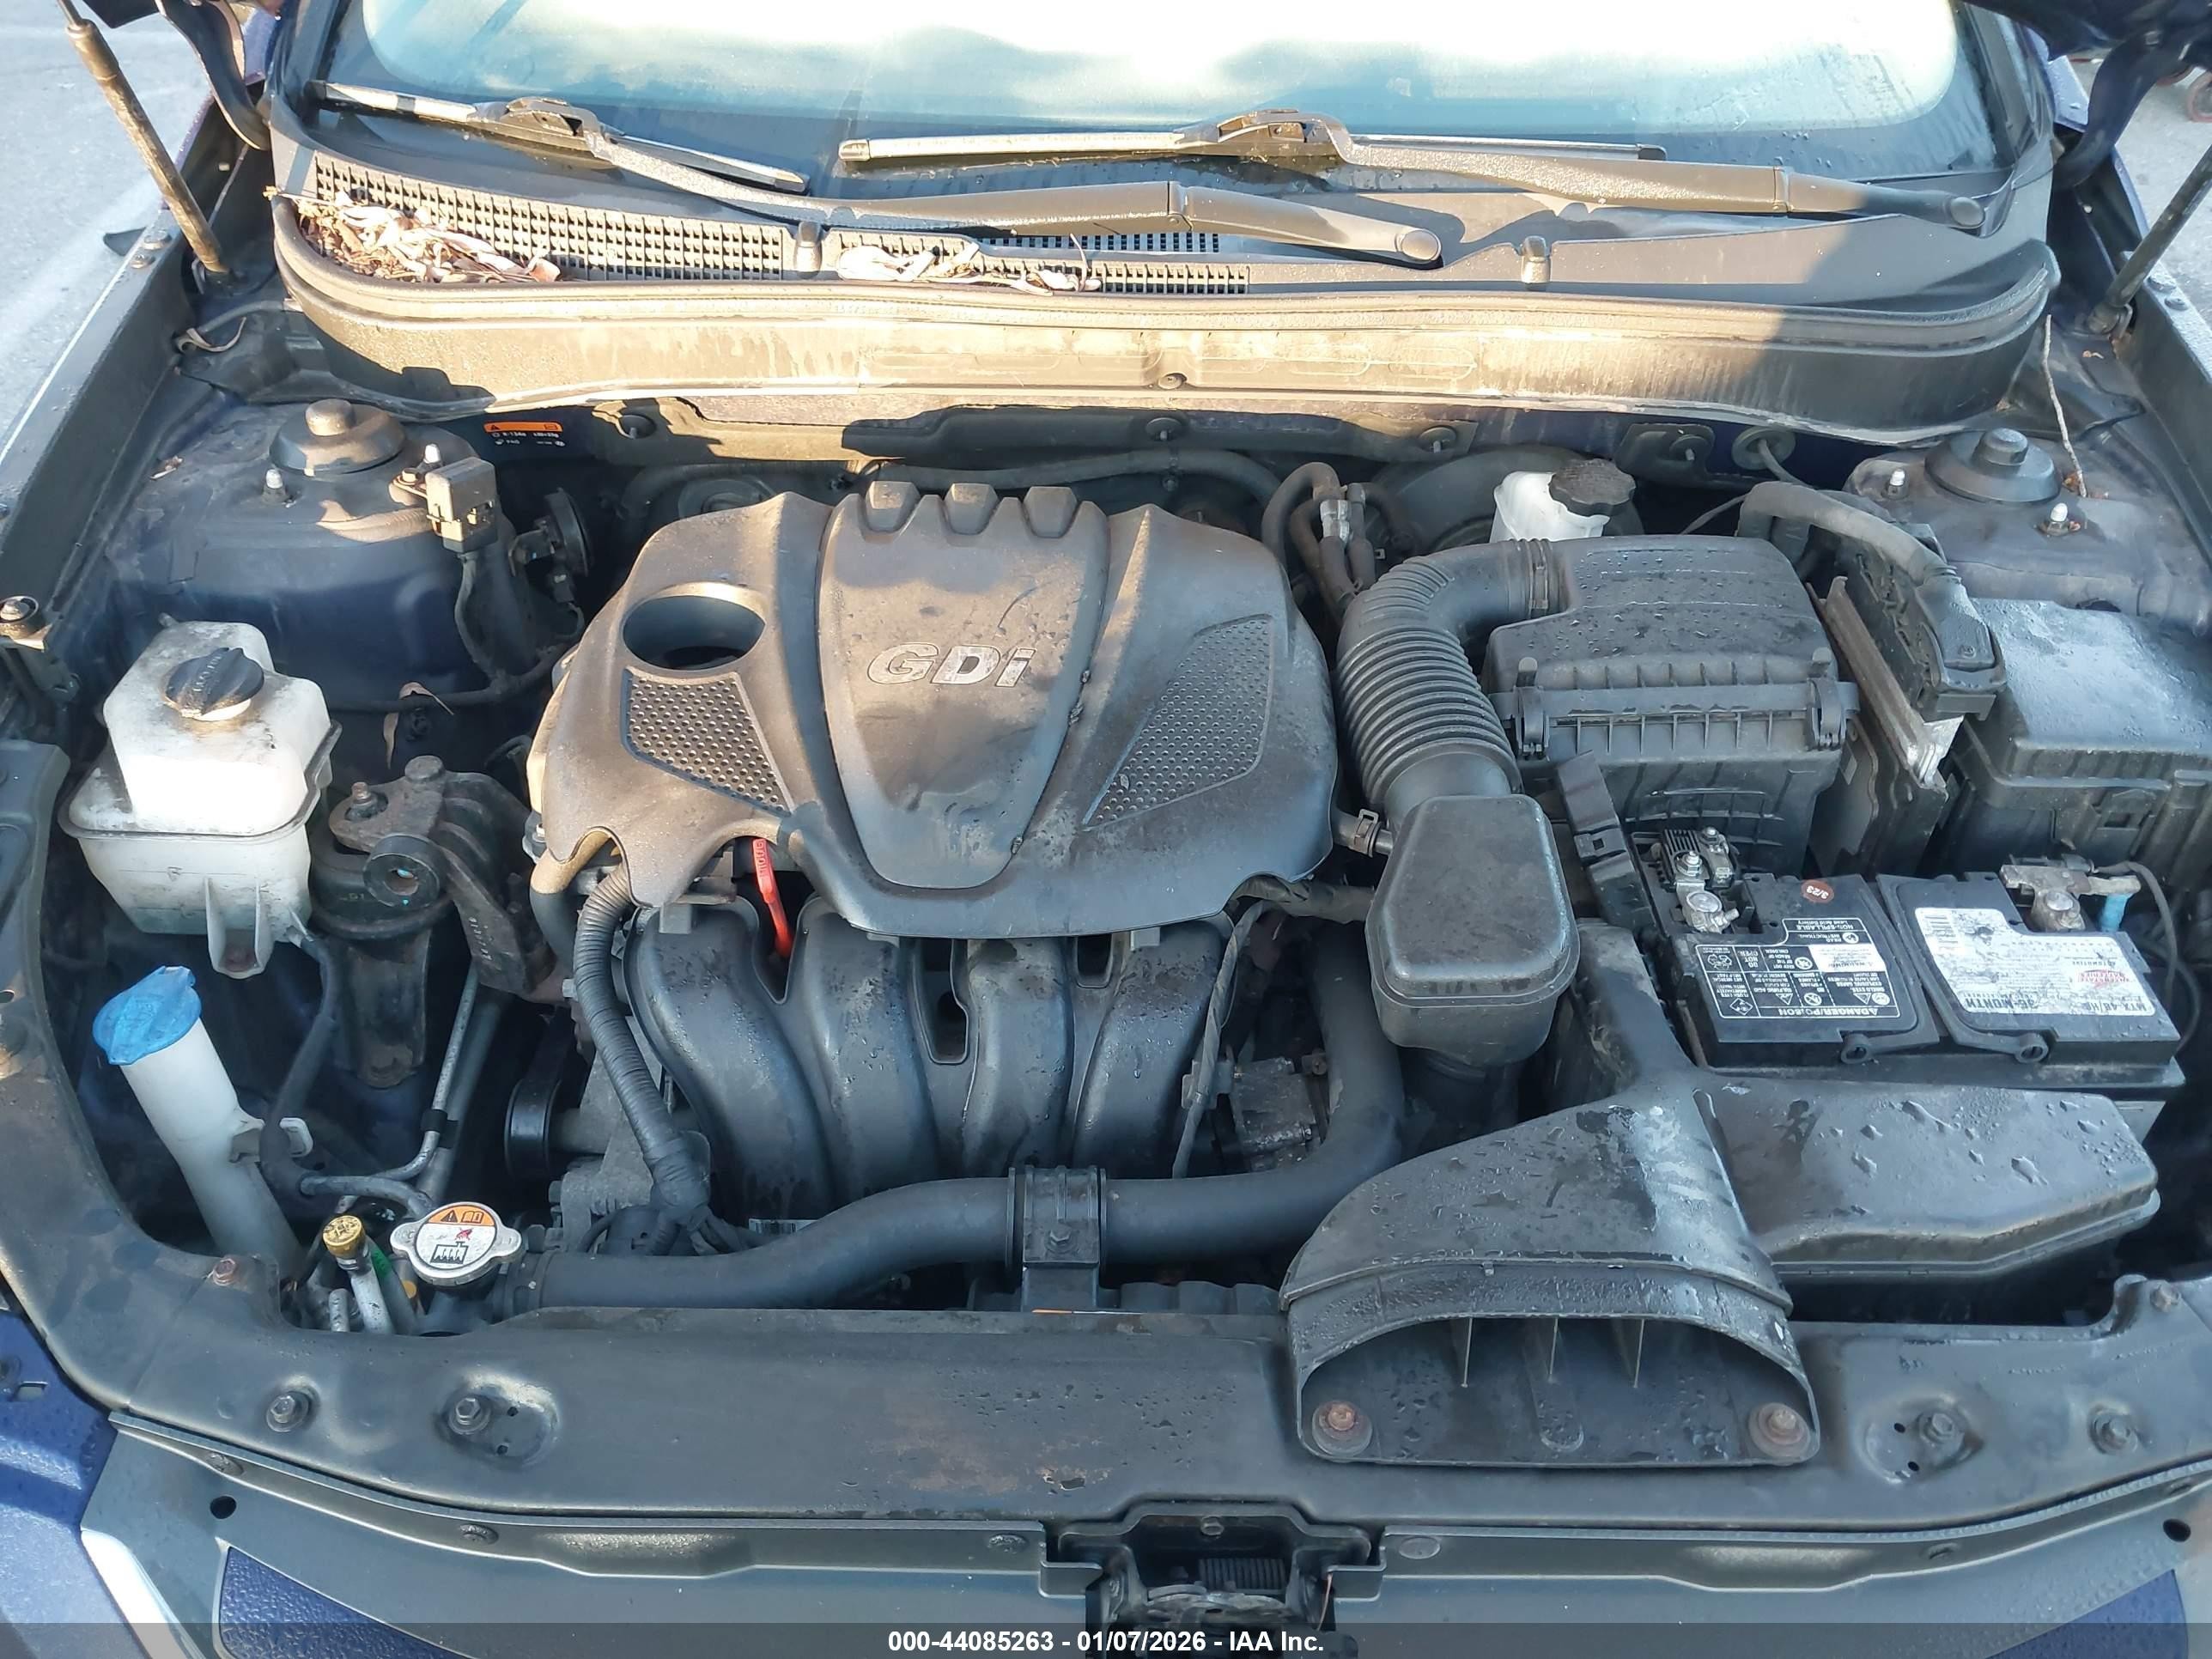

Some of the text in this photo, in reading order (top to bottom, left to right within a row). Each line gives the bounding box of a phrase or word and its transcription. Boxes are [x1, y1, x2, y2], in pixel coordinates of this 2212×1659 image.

[866, 643, 1036, 687] GDi
[1807, 885, 1829, 899] 3/23
[1966, 999, 2037, 1009] 36-MONTH
